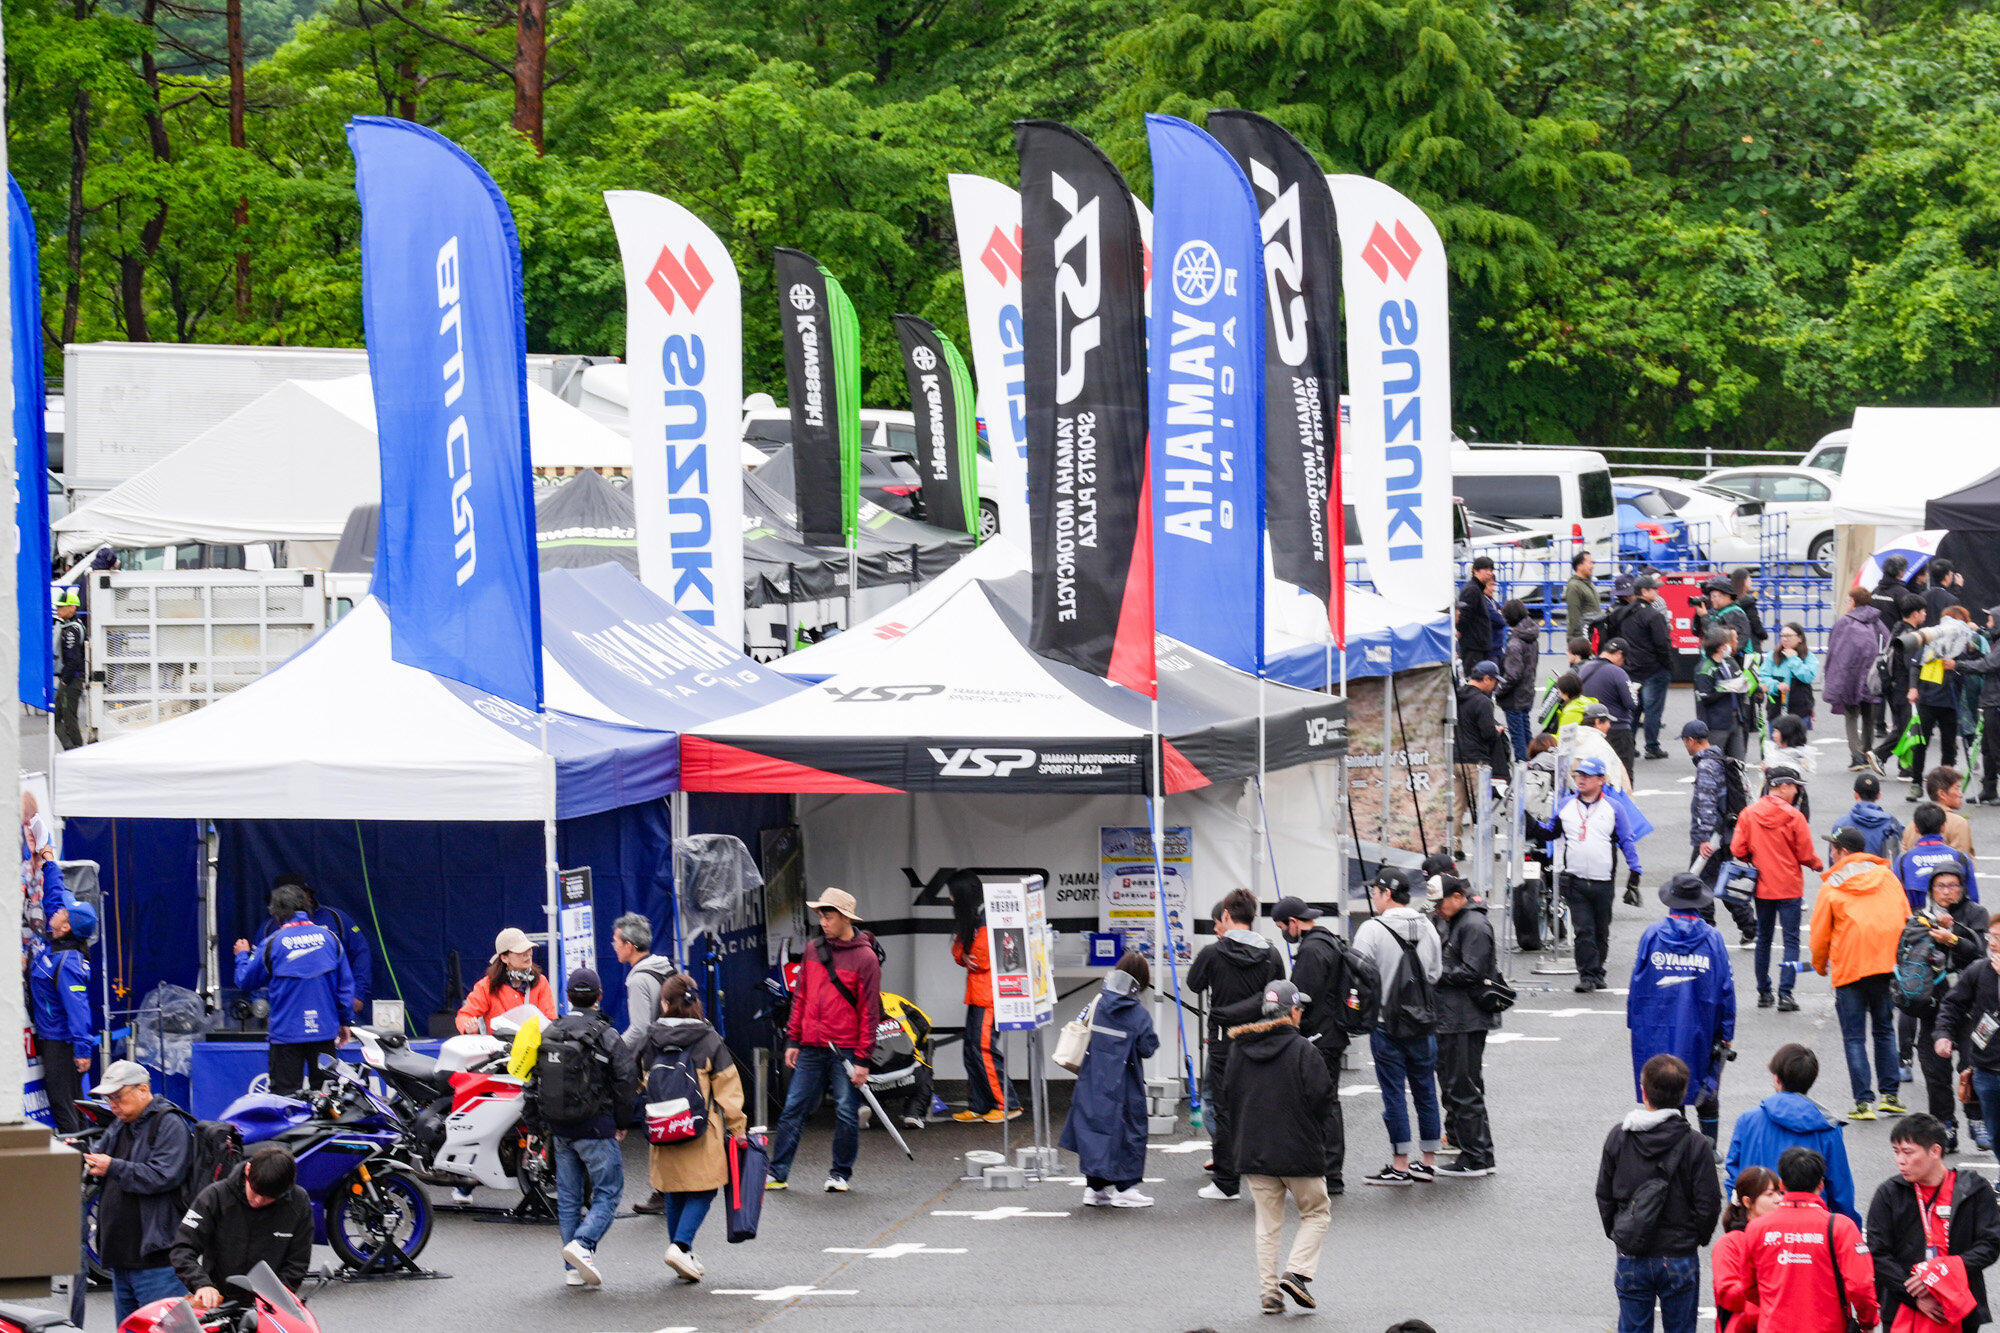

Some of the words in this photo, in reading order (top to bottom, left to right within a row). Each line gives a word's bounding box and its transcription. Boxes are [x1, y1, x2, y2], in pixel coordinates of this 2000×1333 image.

[536, 525, 636, 542] awasaki
[823, 684, 946, 703] YSP
[926, 747, 1036, 777] YSP
[1041, 754, 1079, 764] YAMAHA
[1079, 754, 1137, 764] MOTORCYCLE
[1038, 764, 1073, 775] SPORTS
[1073, 765, 1103, 775] PLAZA
[1056, 888, 1099, 903] SPORT
[1665, 952, 1710, 970] YAMAHA
